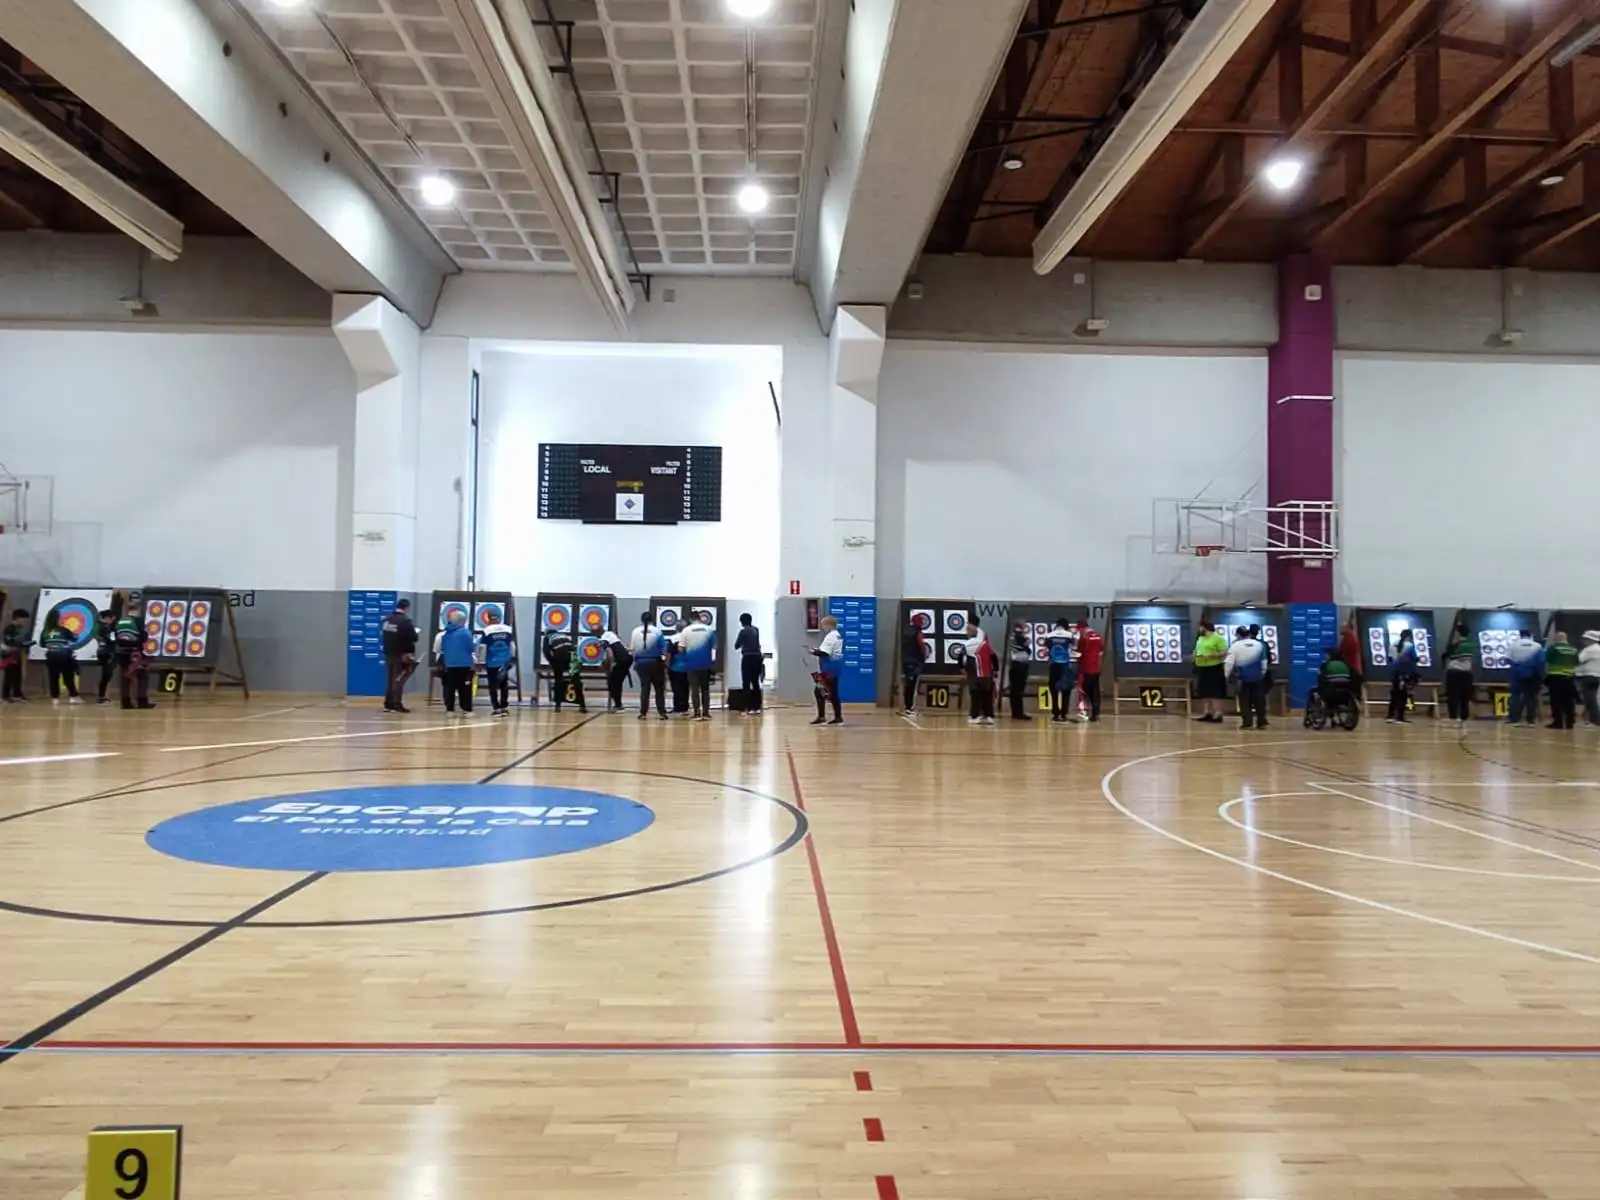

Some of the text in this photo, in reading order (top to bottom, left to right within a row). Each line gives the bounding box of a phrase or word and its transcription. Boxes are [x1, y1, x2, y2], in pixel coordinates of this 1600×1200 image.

[583, 465, 612, 474] LOCAL
[164, 673, 177, 691] 6
[928, 688, 948, 706] 10
[1141, 690, 1163, 706] 12
[258, 802, 600, 817] Encamp
[232, 815, 281, 824] El
[283, 816, 360, 825] Pas
[369, 817, 427, 826] de
[436, 817, 477, 826] la
[299, 826, 493, 837] encamp.ad
[114, 1147, 148, 1200] 9
